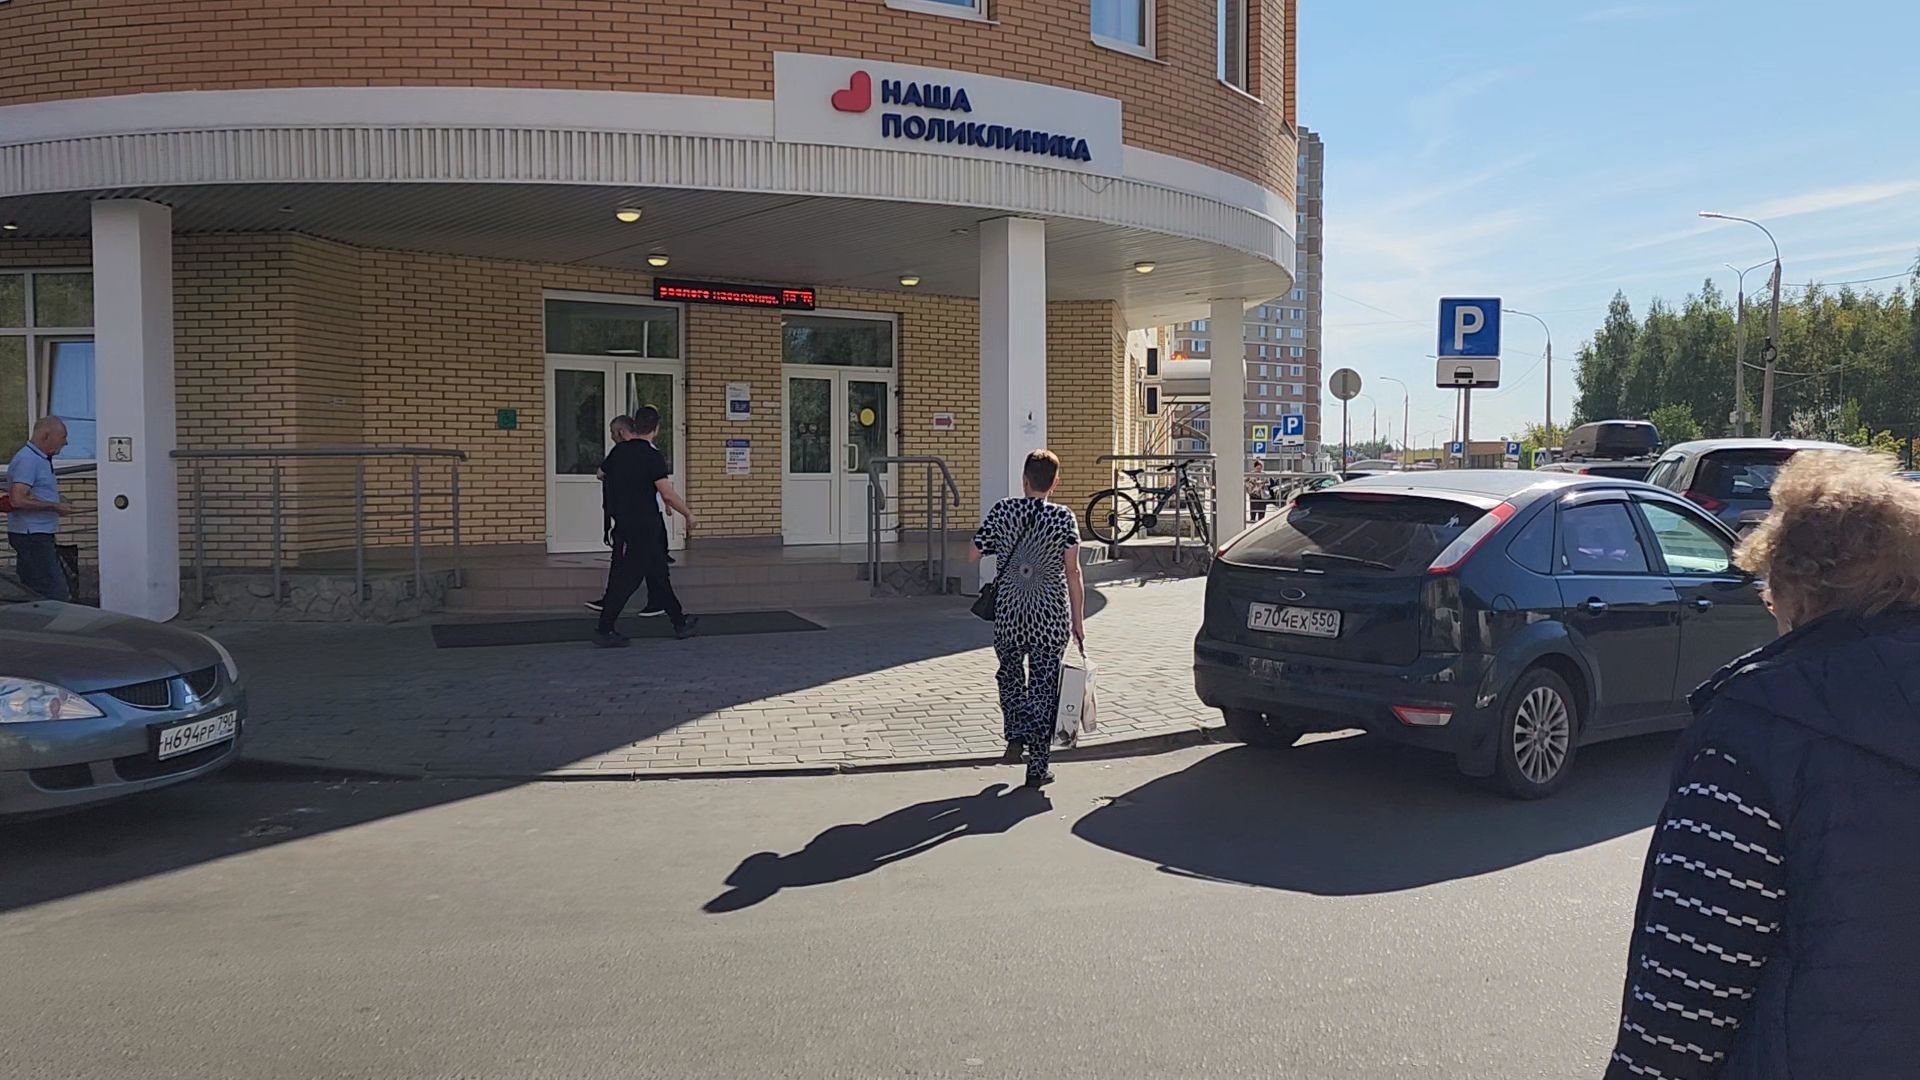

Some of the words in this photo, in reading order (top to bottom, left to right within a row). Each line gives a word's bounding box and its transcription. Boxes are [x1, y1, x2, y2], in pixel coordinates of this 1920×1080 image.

[881, 79, 972, 113] НАША
[881, 113, 1092, 162] ПОЛИКЛИНИКА
[1454, 306, 1485, 350] P
[1287, 417, 1299, 434] P
[1256, 442, 1264, 453] P
[1311, 611, 1335, 628] 550
[217, 713, 234, 731] 790
